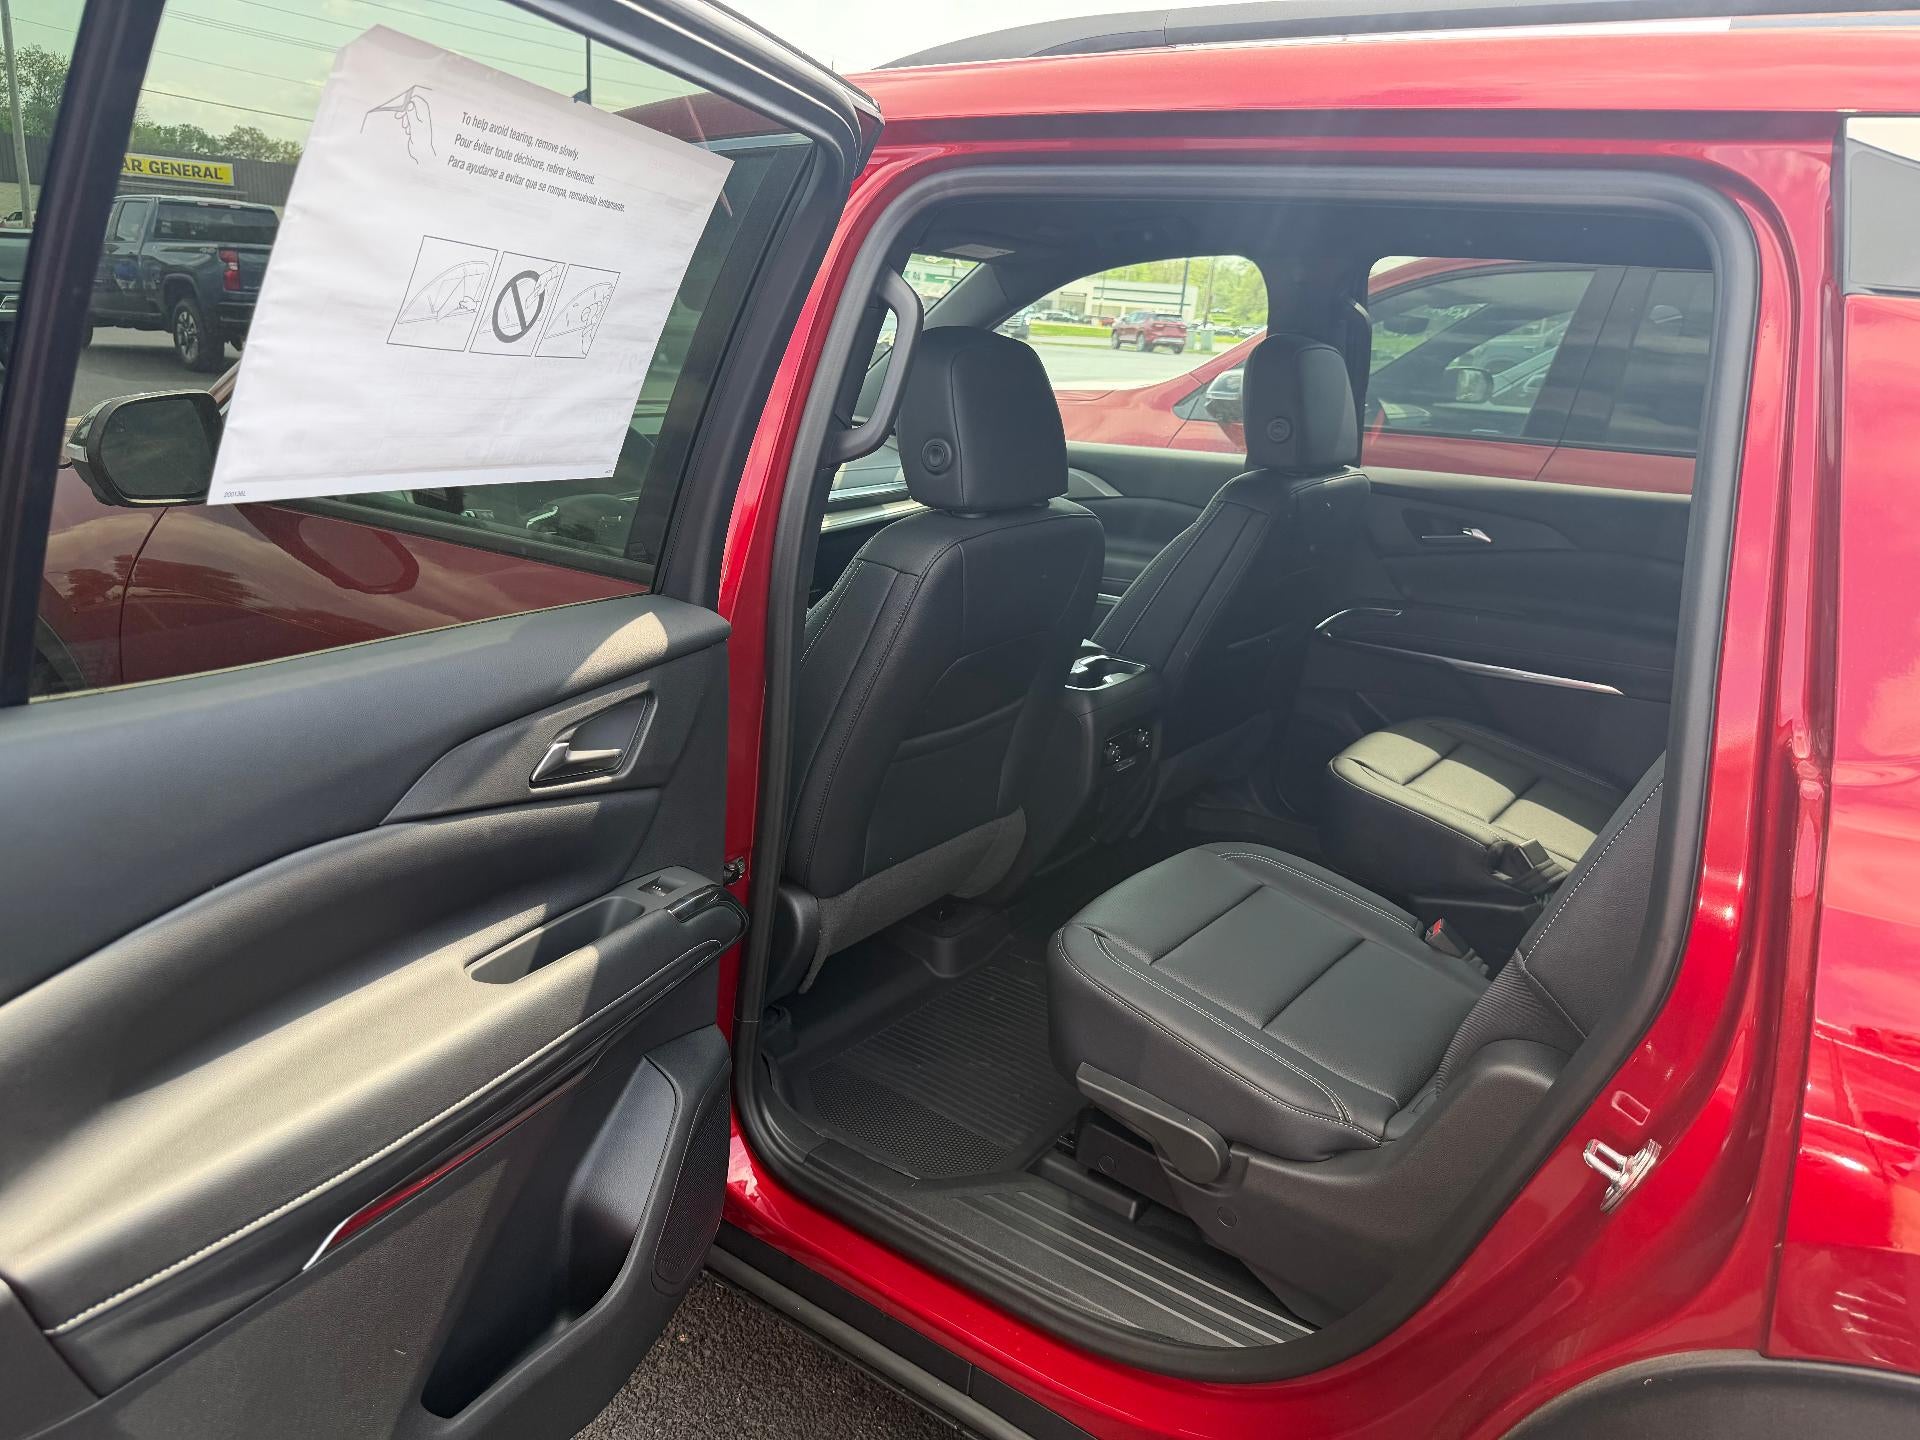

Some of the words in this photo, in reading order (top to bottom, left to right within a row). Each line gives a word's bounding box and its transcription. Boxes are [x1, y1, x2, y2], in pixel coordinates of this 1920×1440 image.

[454, 133, 473, 148] Pour
[473, 138, 494, 155] éviter
[495, 146, 513, 161] toute
[513, 151, 545, 172] déchirure,
[546, 163, 566, 176] retirer
[462, 111, 471, 126] To
[472, 115, 488, 133] help
[489, 122, 509, 137] avoid
[509, 126, 534, 147] tearing,
[535, 138, 559, 153] remove
[559, 144, 579, 160] slowly.
[148, 161, 223, 180] GENERAL
[447, 155, 465, 169] Para
[466, 162, 498, 178] ayudarse
[498, 170, 504, 180] a
[505, 171, 525, 187] evitar
[525, 178, 538, 190] que
[537, 182, 547, 191] se
[547, 184, 567, 199] rompa,
